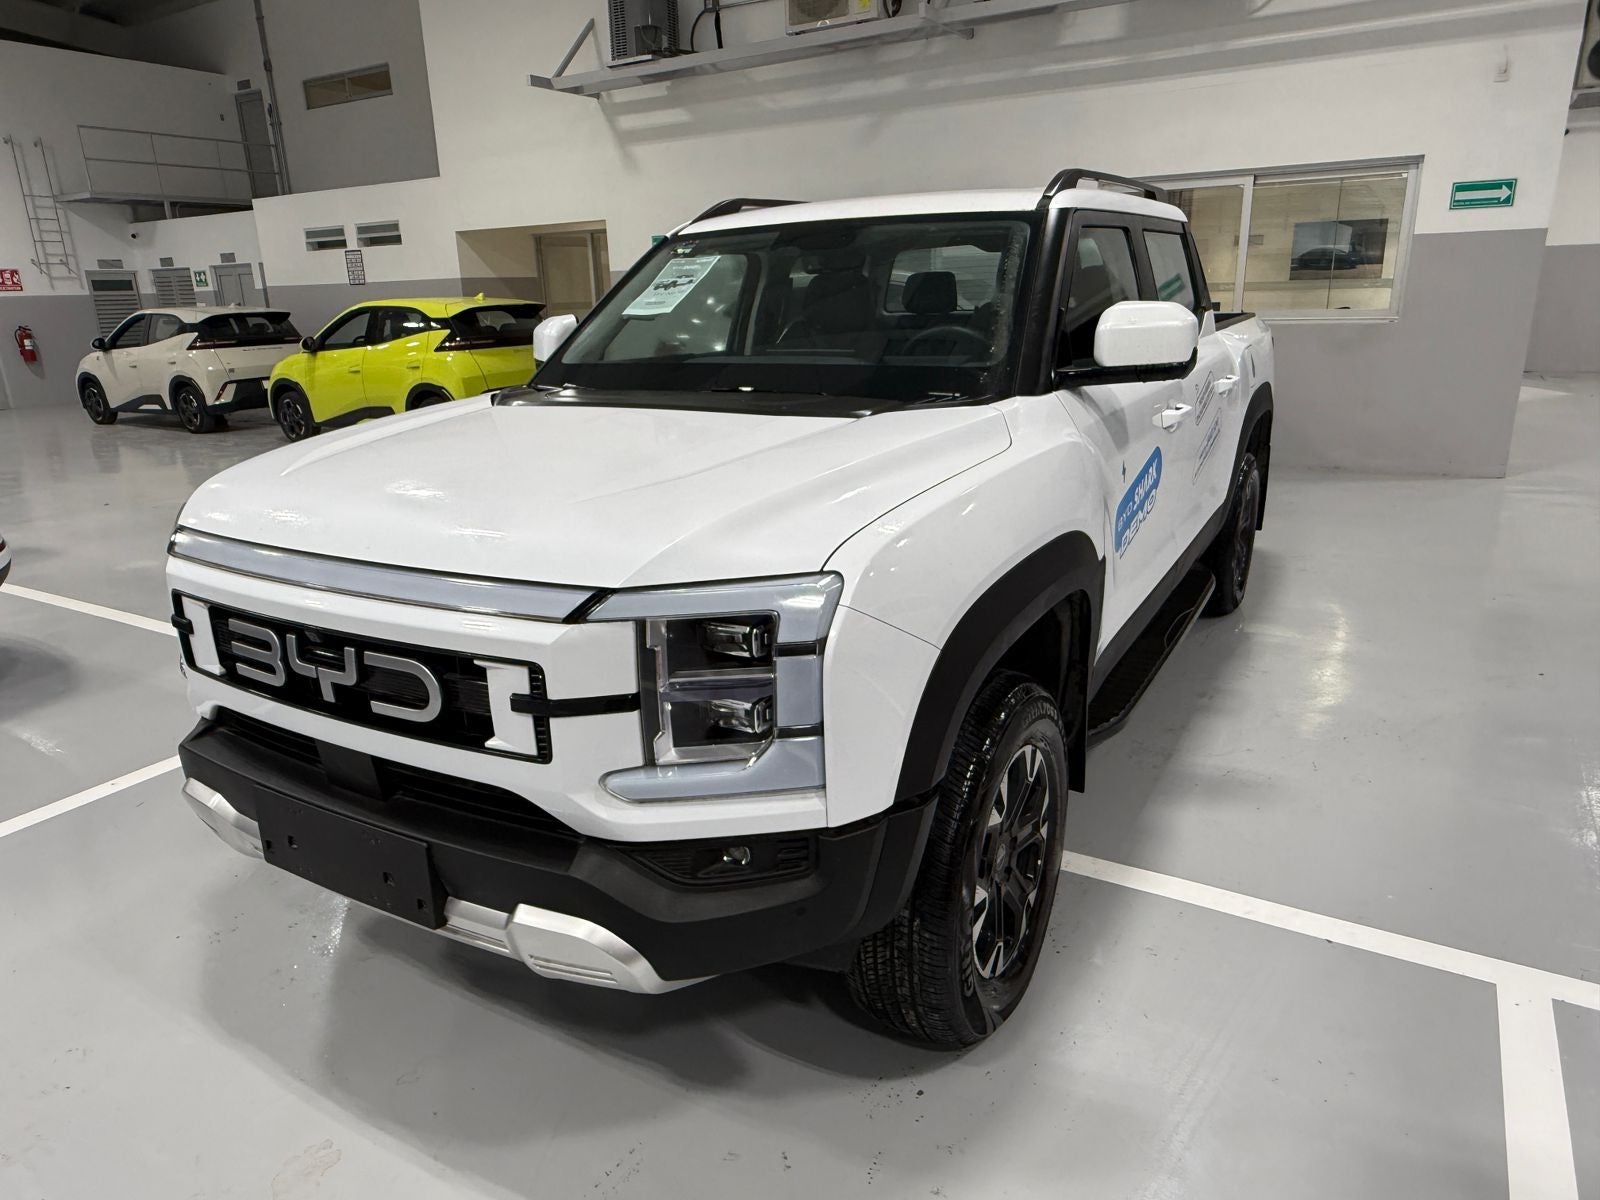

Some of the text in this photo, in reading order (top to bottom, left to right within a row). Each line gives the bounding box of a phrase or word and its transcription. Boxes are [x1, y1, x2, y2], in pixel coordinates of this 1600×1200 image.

[1117, 458, 1158, 532] BYD SHARK
[1119, 488, 1157, 559] DEMO
[227, 617, 443, 723] BYD
